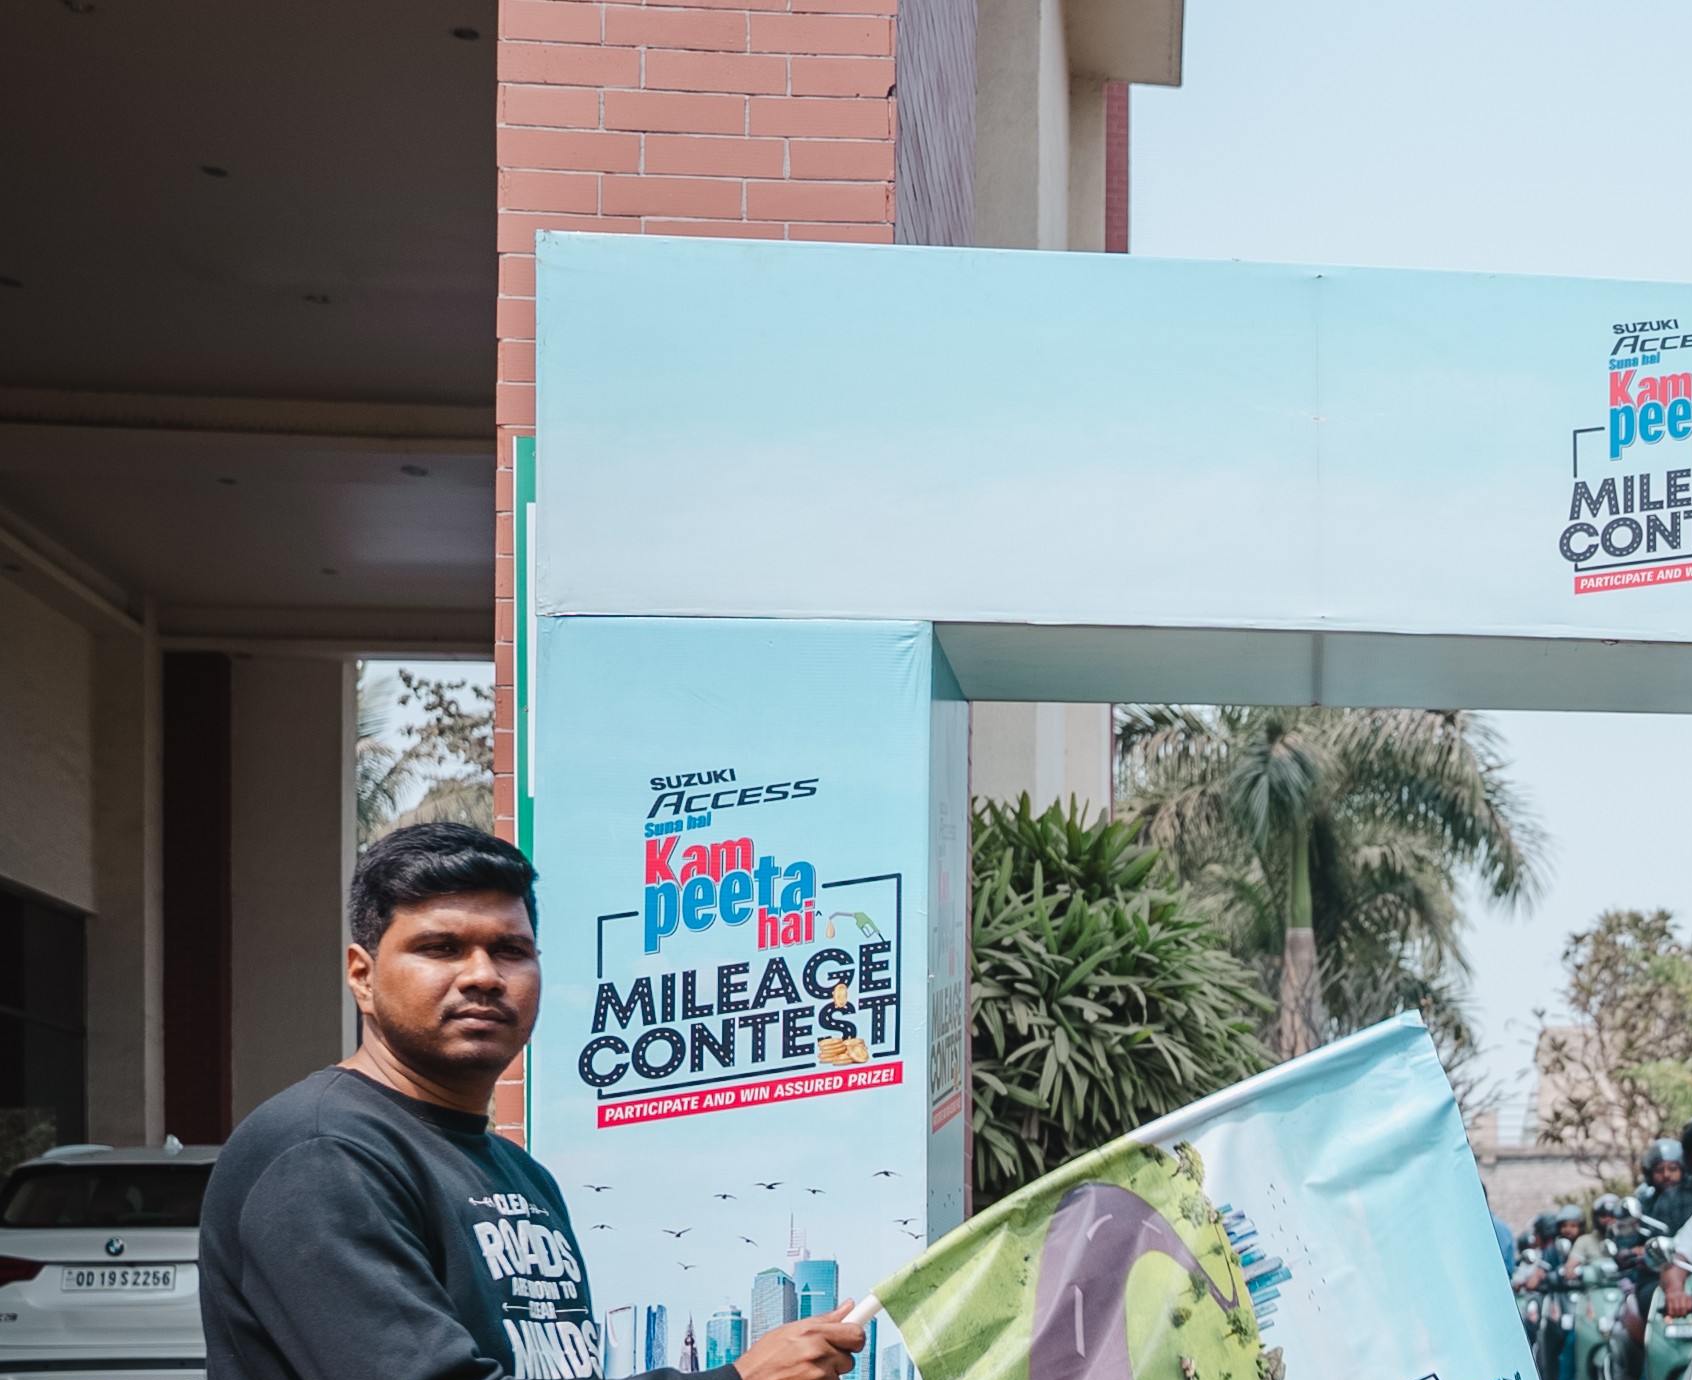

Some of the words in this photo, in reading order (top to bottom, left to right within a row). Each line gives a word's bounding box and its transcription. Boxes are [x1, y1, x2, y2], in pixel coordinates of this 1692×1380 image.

[1612, 319, 1679, 335] SUZUKI
[1580, 571, 1653, 590] PARTICIPATE
[1656, 567, 1682, 581] AND
[646, 779, 820, 819] ACCESS
[650, 768, 737, 791] SUZUKI
[645, 835, 754, 887] Kam
[644, 855, 816, 955] peeta
[757, 900, 815, 951] hai
[591, 940, 892, 1035] MILEAGE
[578, 998, 897, 1088] CONTEST
[604, 1096, 699, 1123] PARTICIPATE
[702, 1090, 735, 1108] AND
[739, 1085, 770, 1102] WIN
[773, 1076, 843, 1098] ASSURED
[847, 1068, 895, 1087] PRIZE!
[473, 1218, 582, 1283] ROADS
[101, 1271, 117, 1287] 19
[120, 1271, 129, 1286] S
[132, 1271, 171, 1286] 2256
[559, 1281, 578, 1299] TO
[502, 1319, 604, 1380] MINDS
